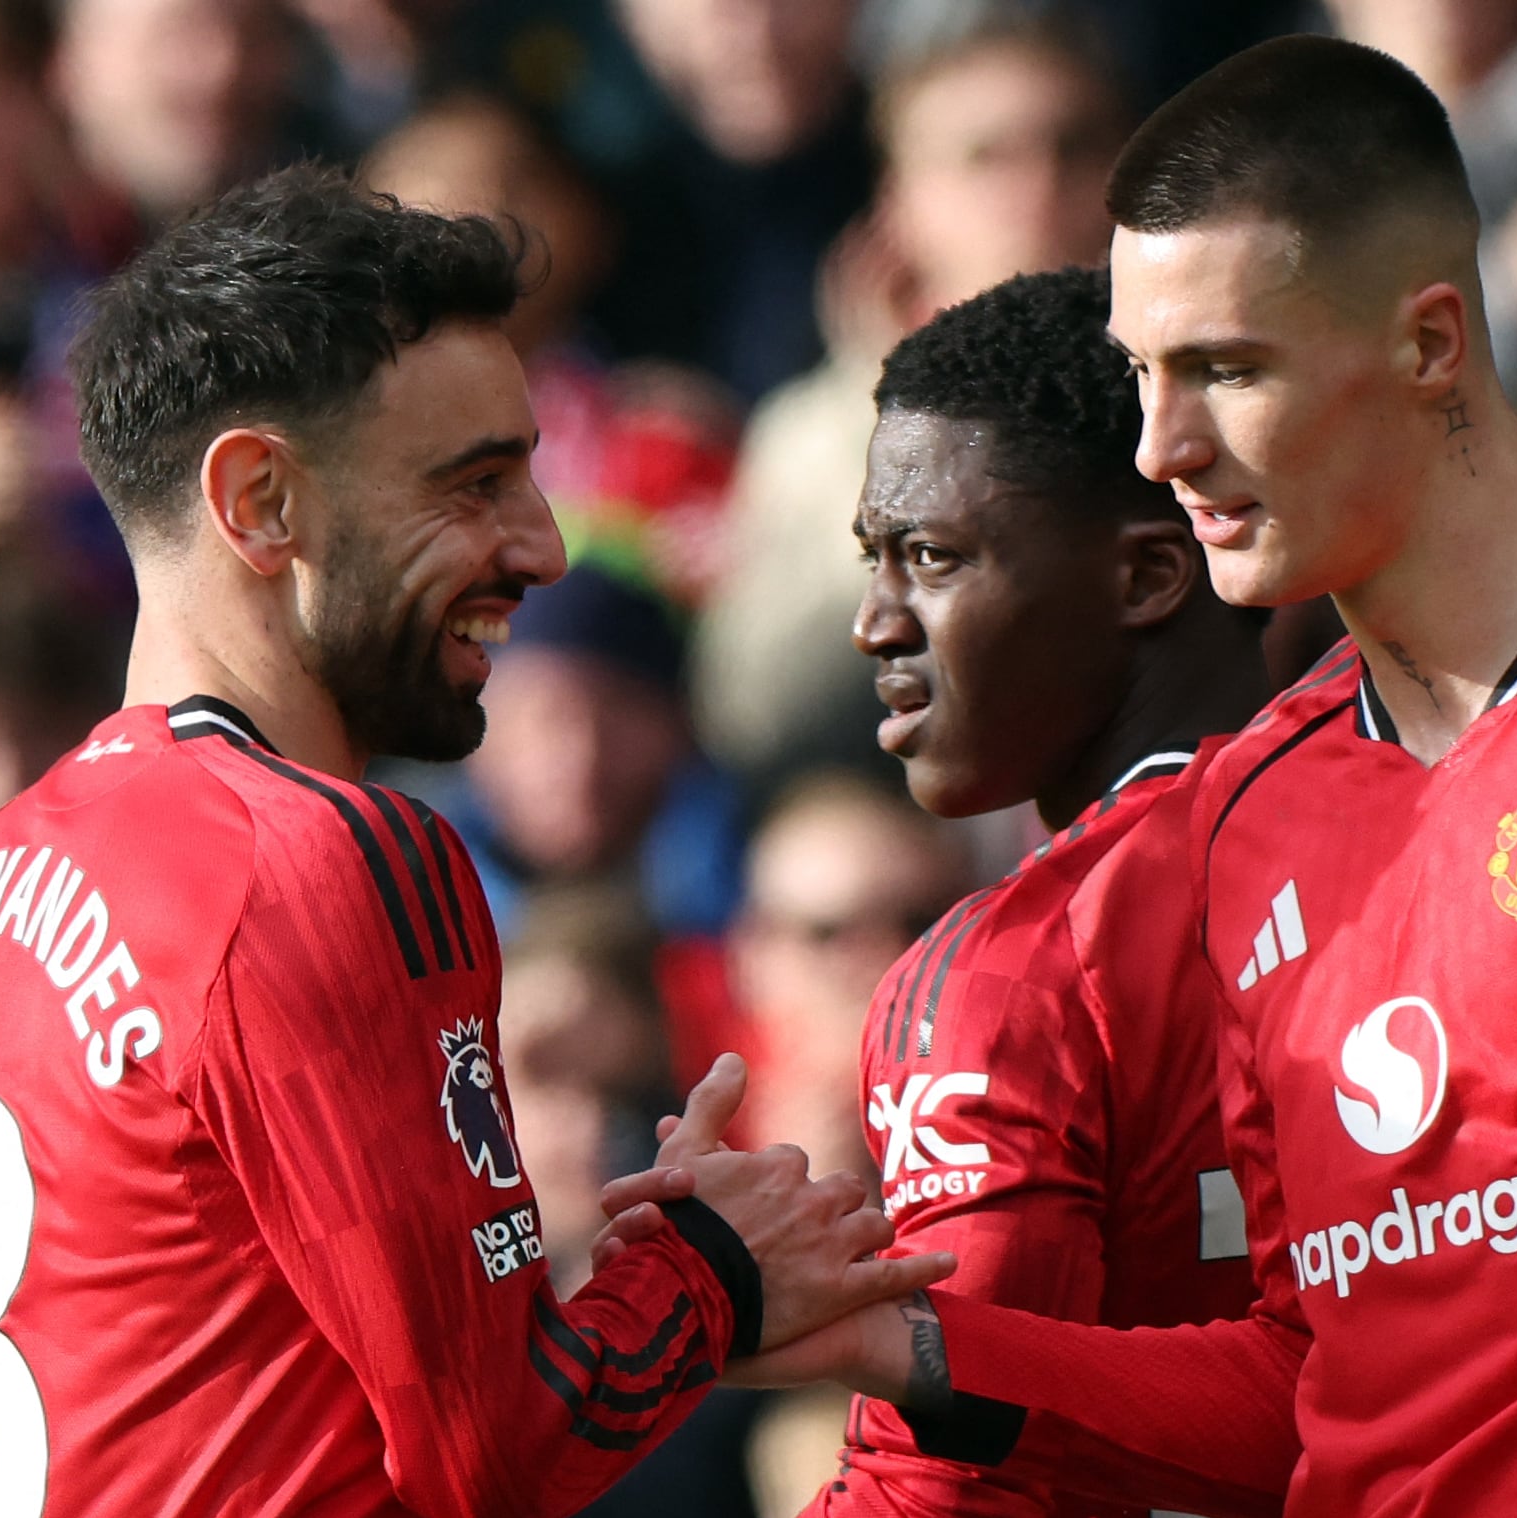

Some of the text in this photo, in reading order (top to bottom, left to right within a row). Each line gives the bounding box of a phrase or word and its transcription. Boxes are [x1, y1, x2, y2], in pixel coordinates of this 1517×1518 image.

[868, 1071, 992, 1182] XC
[471, 1221, 511, 1258] No
[509, 1207, 534, 1237] ro
[482, 1243, 520, 1284] for
